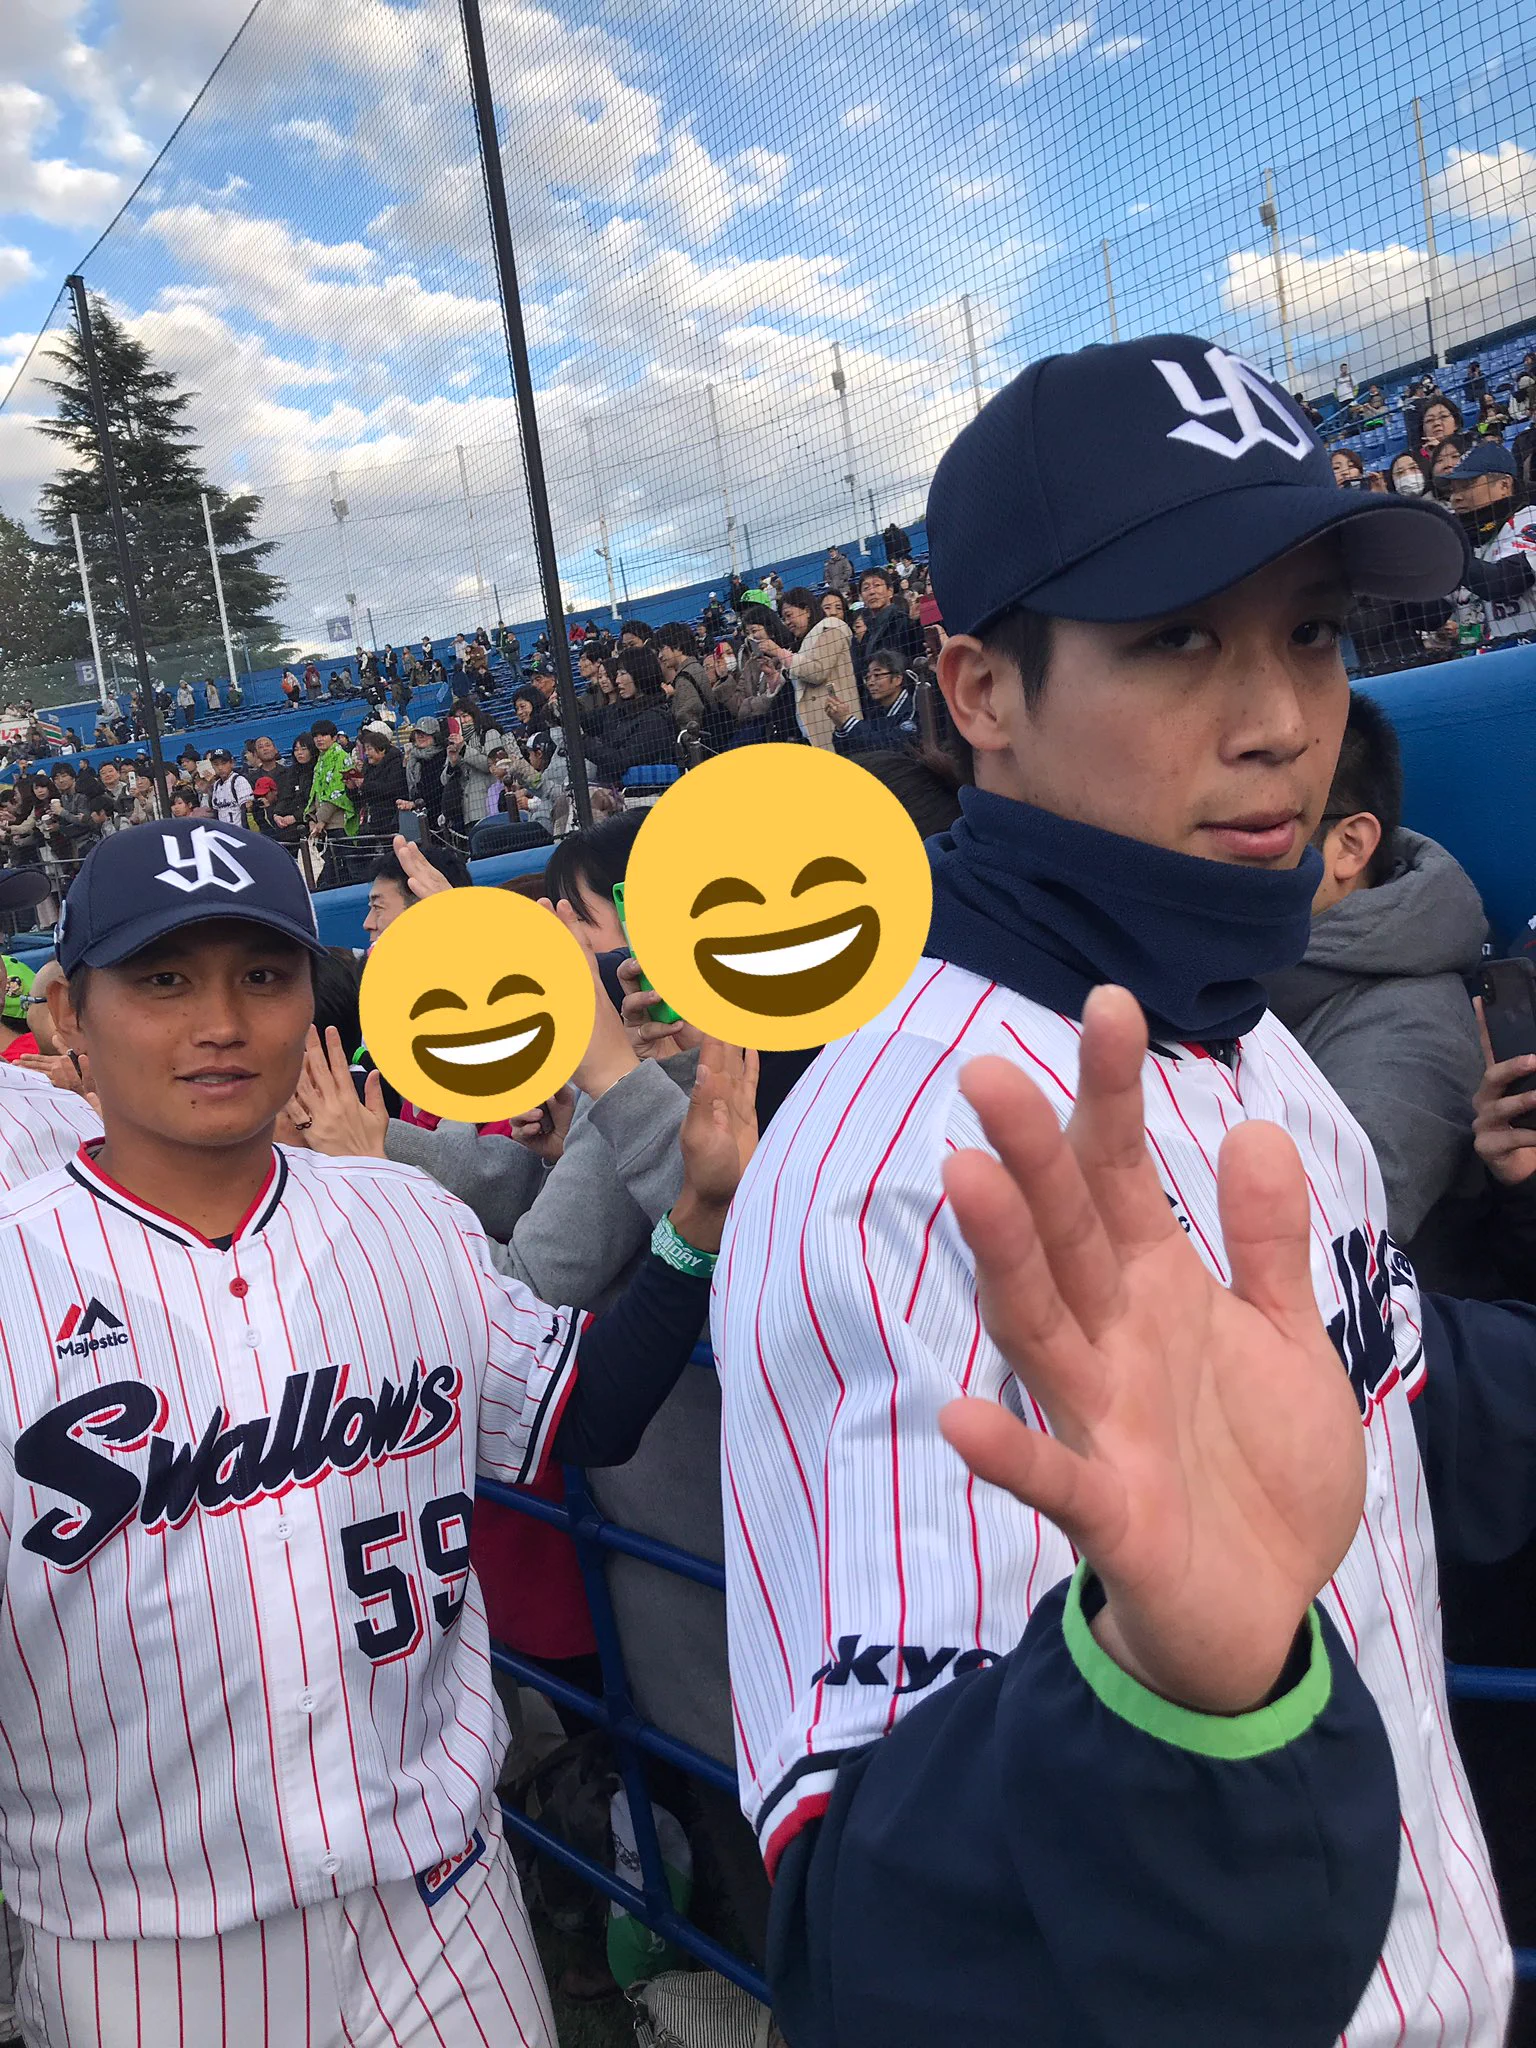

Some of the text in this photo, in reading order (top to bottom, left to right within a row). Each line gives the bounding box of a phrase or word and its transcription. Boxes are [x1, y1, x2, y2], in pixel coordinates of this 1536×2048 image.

[333, 622, 348, 638] A
[82, 665, 96, 682] B
[56, 1331, 129, 1360] Majestic
[15, 1357, 463, 1574] Swallows
[340, 1491, 474, 1667] 59
